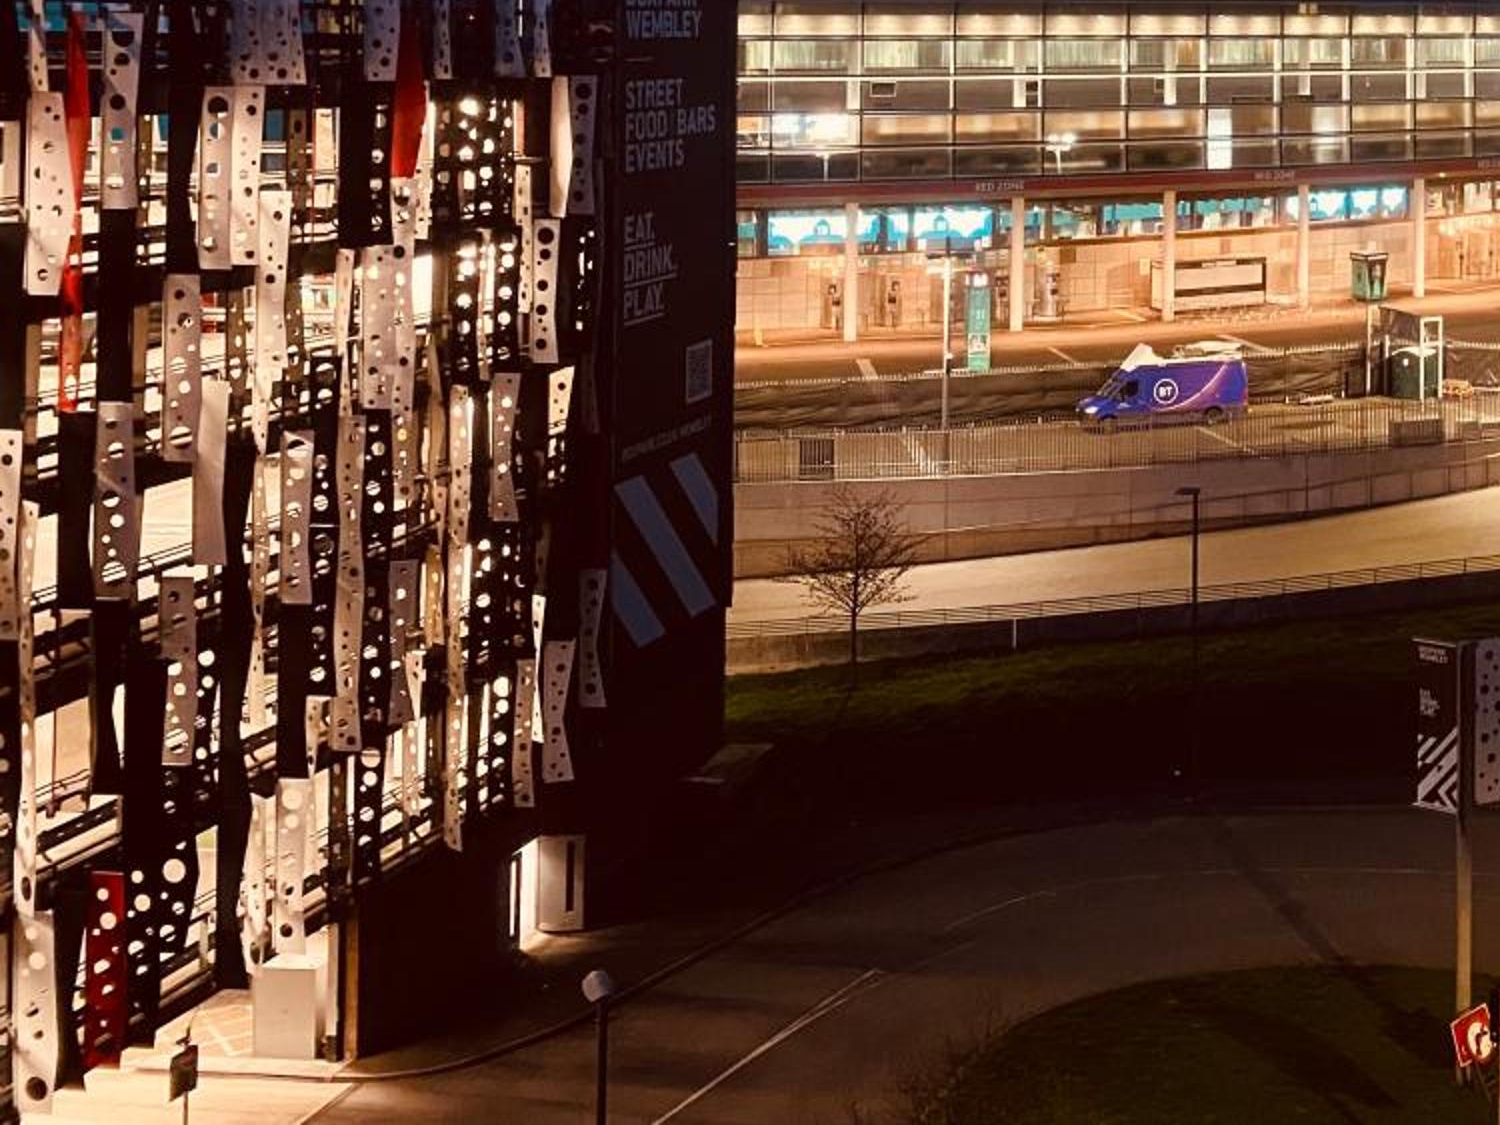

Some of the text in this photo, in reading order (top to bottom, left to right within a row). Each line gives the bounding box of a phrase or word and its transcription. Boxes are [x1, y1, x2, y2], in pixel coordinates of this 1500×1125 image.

[625, 10, 704, 40] WEMBLEY
[624, 77, 684, 110] STREET
[625, 104, 717, 143] FOOD BARS
[624, 138, 686, 174] EVENTS
[1159, 386, 1173, 398] BT
